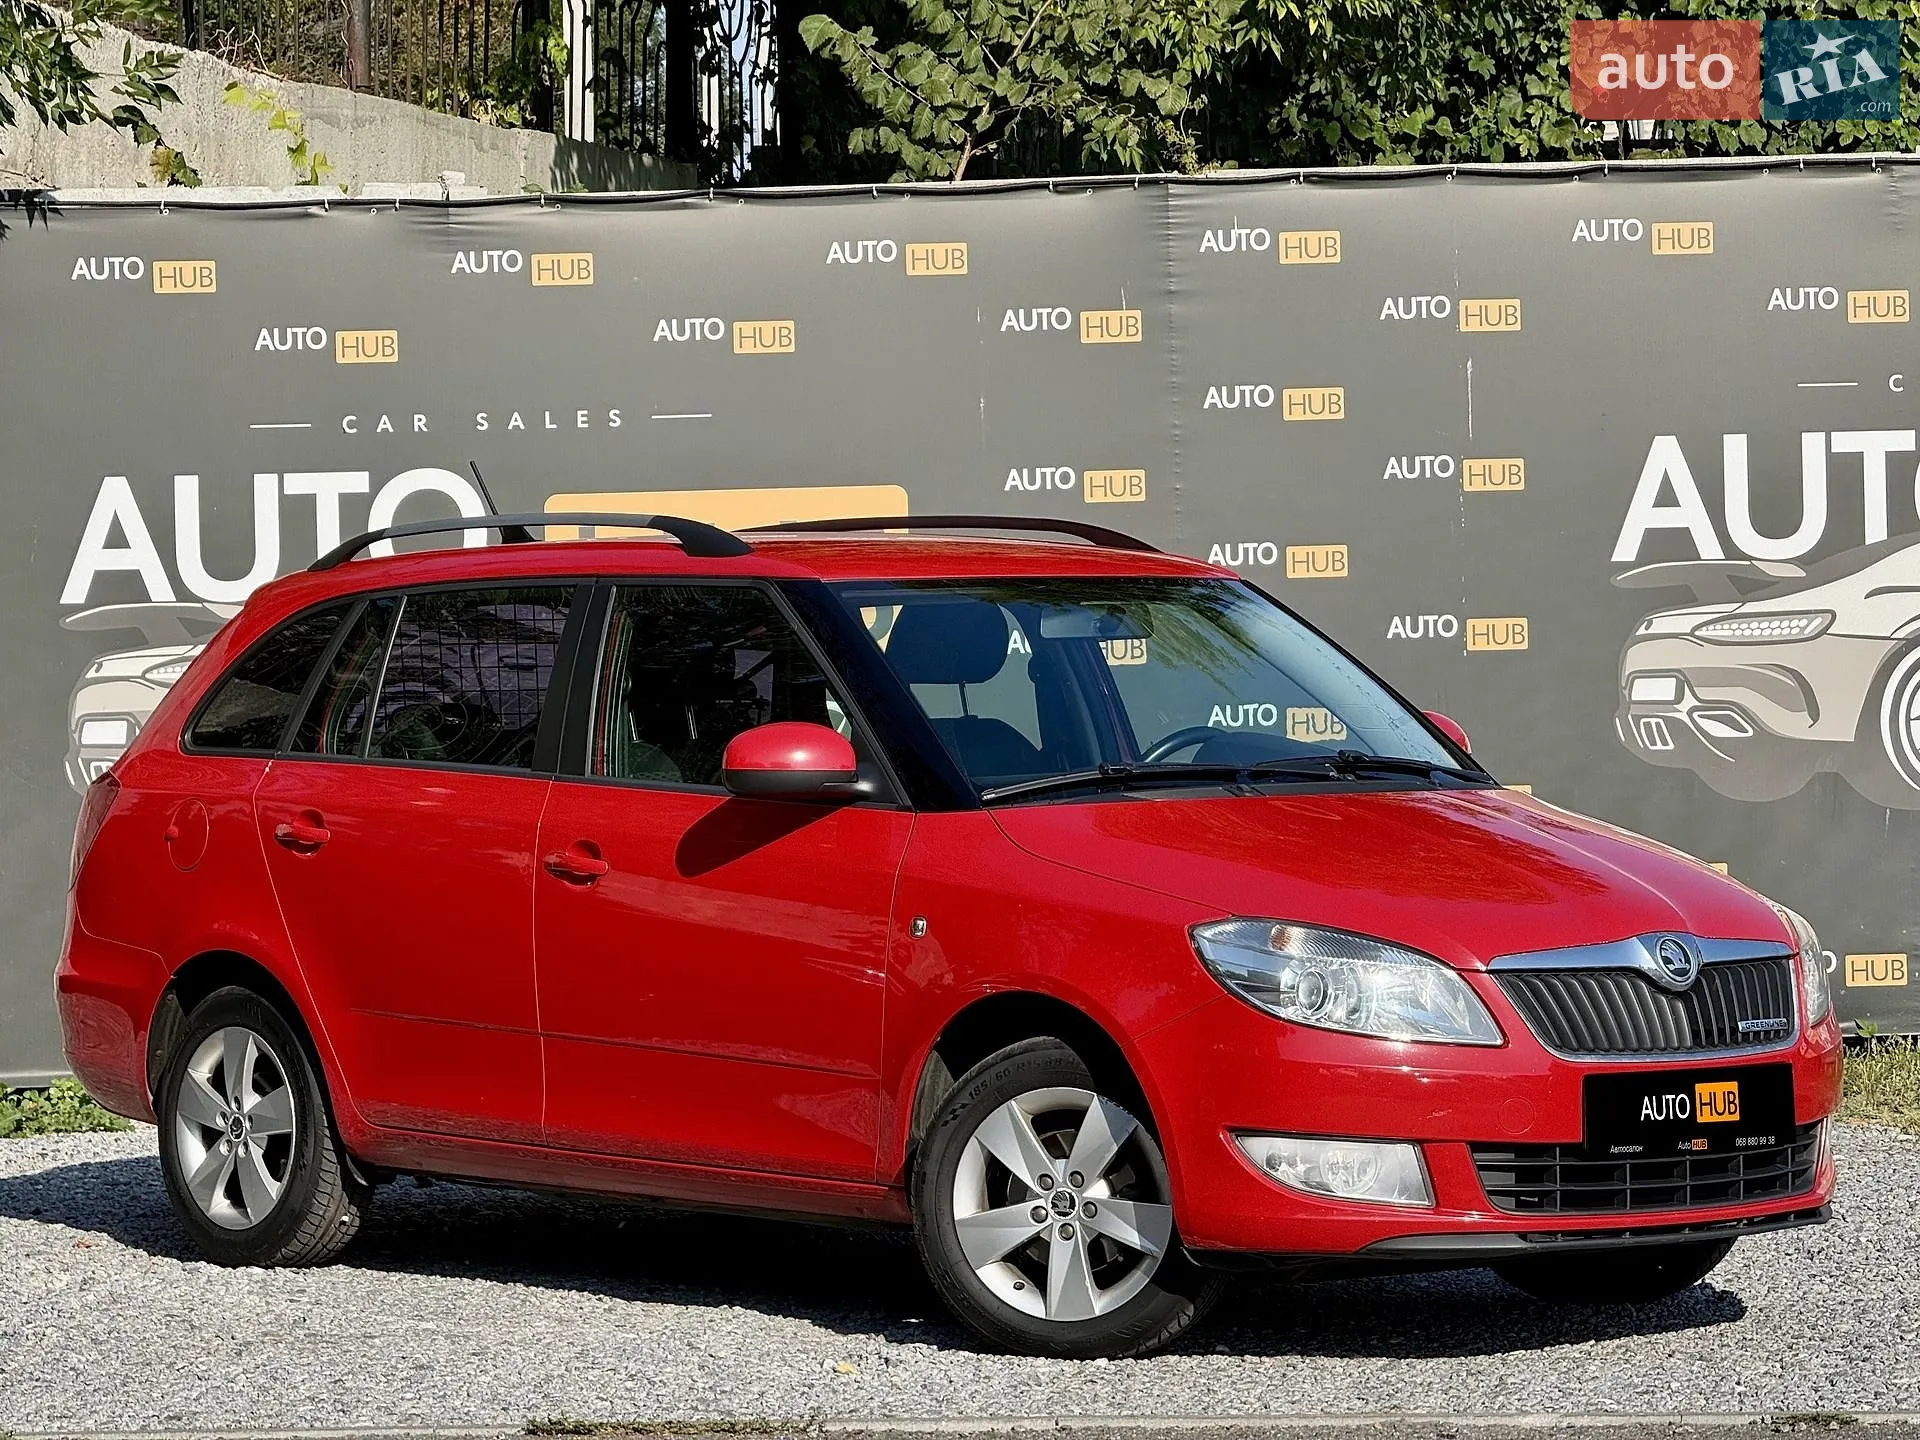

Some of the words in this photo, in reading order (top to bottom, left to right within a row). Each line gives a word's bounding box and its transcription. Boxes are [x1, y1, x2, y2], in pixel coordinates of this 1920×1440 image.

[1199, 227, 1270, 252] AUTO
[1284, 236, 1338, 260] HUB
[1572, 218, 1643, 243] AUTO
[1657, 227, 1710, 251] HUB
[451, 249, 523, 273] AUTO
[537, 258, 591, 281] HUB
[826, 239, 897, 264] AUTO
[911, 248, 965, 271] HUB
[72, 256, 144, 280] AUTO
[158, 266, 213, 289] HUB
[1380, 295, 1450, 319] AUTO
[1465, 304, 1518, 327] HUB
[1768, 286, 1839, 311] AUTO
[1853, 295, 1906, 319] HUB
[653, 317, 725, 342] AUTO
[738, 326, 792, 349] HUB
[1000, 306, 1072, 331] AUTO
[1085, 315, 1139, 339] HUB
[255, 326, 327, 350] AUTO
[341, 335, 395, 359] HUB
[1203, 384, 1274, 409] AUTO
[1288, 392, 1342, 416] HUB
[342, 413, 428, 433] CAR
[476, 408, 622, 431] SALES
[1004, 466, 1075, 491] AUTO
[1089, 475, 1143, 498] HUB
[1383, 454, 1454, 479] AUTO
[1469, 463, 1522, 487] HUB
[1610, 428, 1920, 561] AUT
[1208, 541, 1278, 566] AUTO
[1292, 550, 1345, 574] HUB
[1387, 614, 1458, 639] AUTO
[1472, 623, 1525, 646] HUB
[1208, 703, 1278, 727] AUTO
[1292, 711, 1344, 736] HUB
[1851, 959, 1904, 982] HUB
[1641, 1093, 1691, 1121] AUTO
[1698, 1091, 1738, 1117] HUB
[1678, 1141, 1691, 1150] Auto
[1692, 1139, 1707, 1149] HUB
[1736, 1137, 1747, 1146] 068
[1747, 1136, 1758, 1145] 880
[1759, 1136, 1767, 1145] 99
[1767, 1135, 1776, 1144] 38
